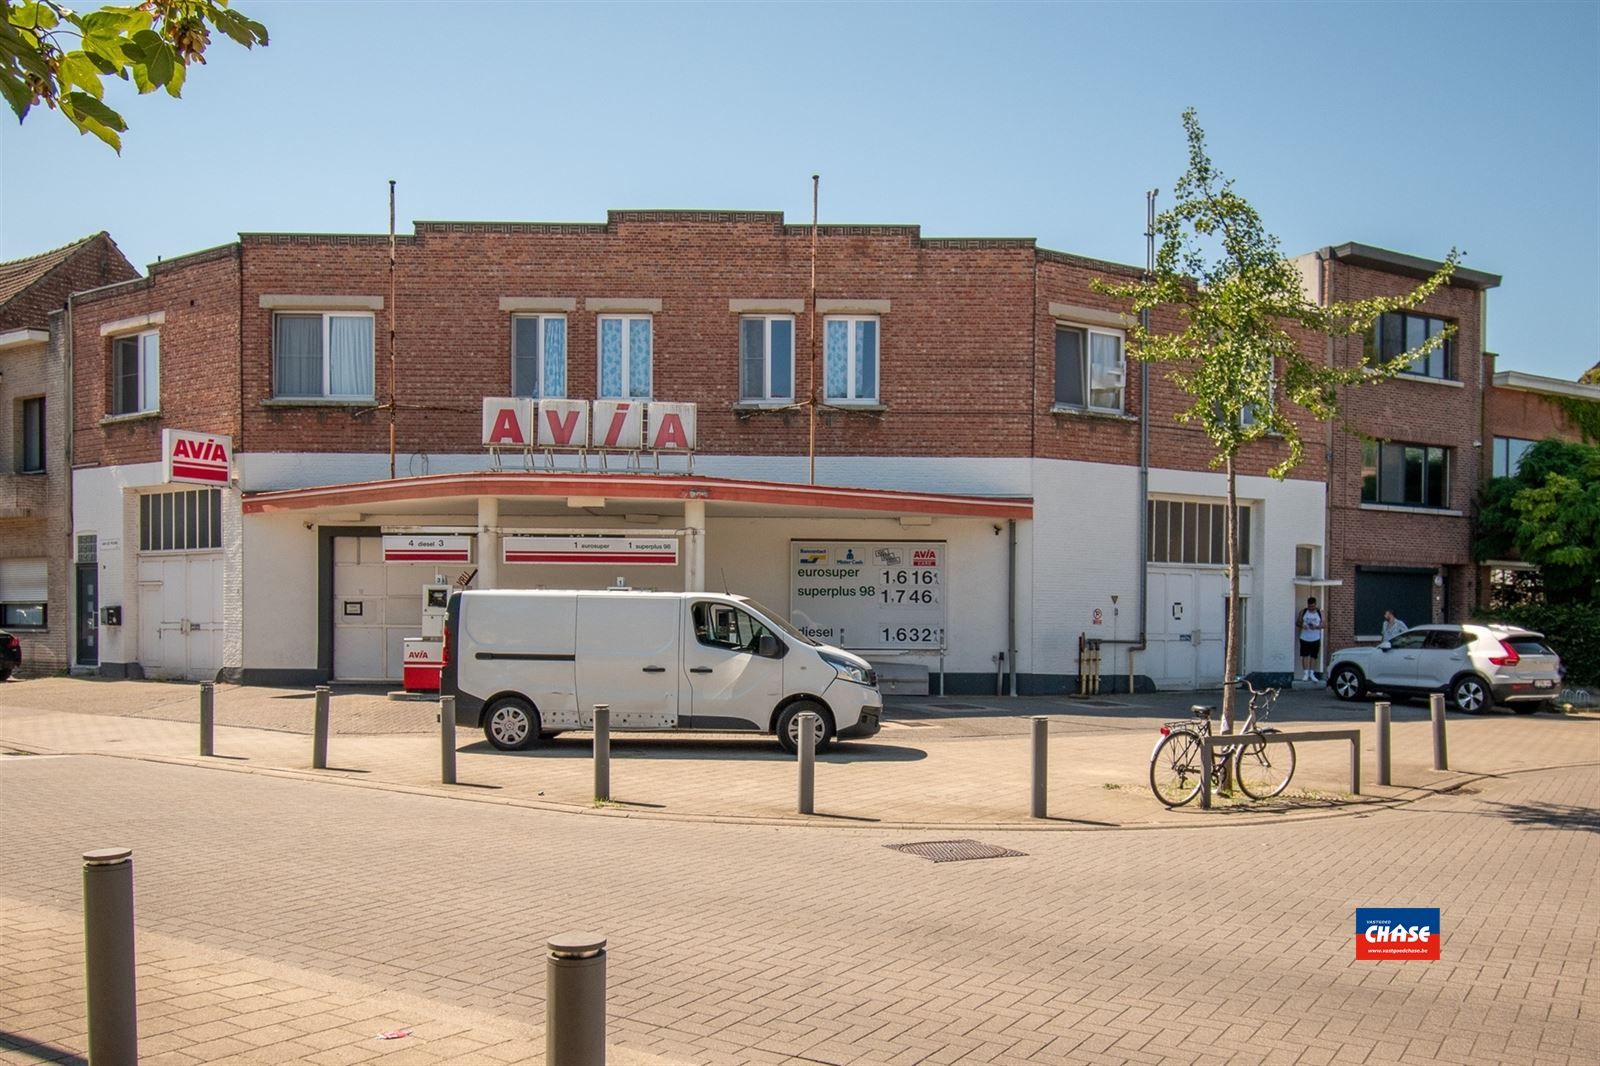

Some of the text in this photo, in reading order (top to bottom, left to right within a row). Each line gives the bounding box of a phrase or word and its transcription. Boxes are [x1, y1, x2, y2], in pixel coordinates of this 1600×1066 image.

[797, 568, 860, 579] eurosuper
[797, 586, 857, 598] superplus
[859, 586, 876, 597] 98
[882, 628, 932, 642] 1,632
